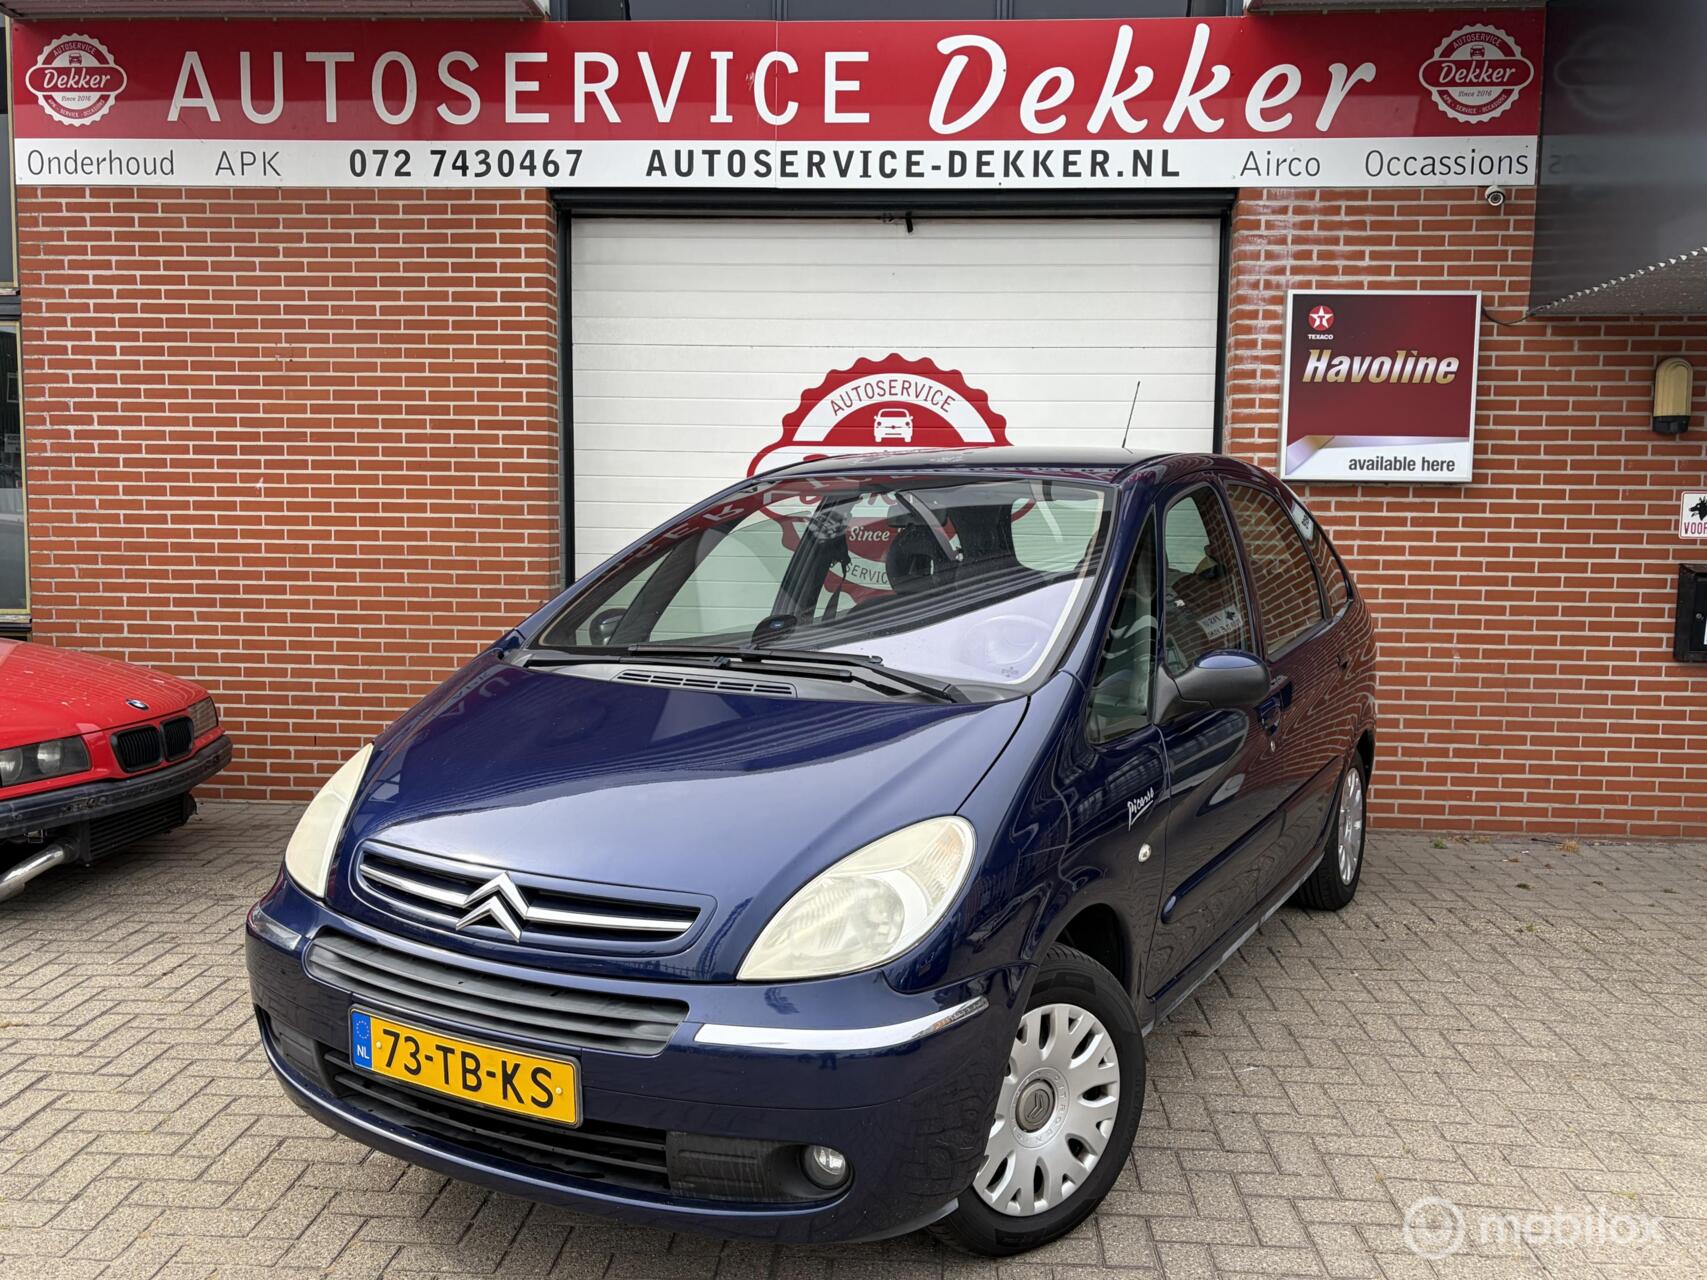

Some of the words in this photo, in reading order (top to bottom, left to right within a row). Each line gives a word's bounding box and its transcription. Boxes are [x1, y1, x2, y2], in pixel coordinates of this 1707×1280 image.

[53, 42, 97, 56] AUTOSERVICE
[1453, 33, 1501, 48] AUTOSERVICE
[43, 67, 111, 89] Dekker
[167, 50, 870, 126] AUTOSERVICE
[928, 23, 1377, 135] Dekker
[1439, 60, 1516, 83] Dekker
[1476, 89, 1492, 97] 2016
[27, 148, 174, 177] Onderhoud
[215, 150, 282, 177] APK
[350, 149, 412, 178] 072
[430, 149, 584, 178] 7430467
[646, 149, 1180, 178] AUTOSERVICE-DEKKER.NL
[1240, 150, 1321, 177] Airco
[1366, 147, 1528, 177] Occassions
[1302, 349, 1460, 384] Havoline
[830, 379, 956, 417] AUTOSERVICE
[1348, 456, 1416, 472] available
[1421, 456, 1455, 472] here
[849, 525, 890, 541] Since
[846, 562, 889, 585] SERVIC
[356, 1044, 370, 1060] NL
[382, 1028, 554, 1108] 73-TB-KS
